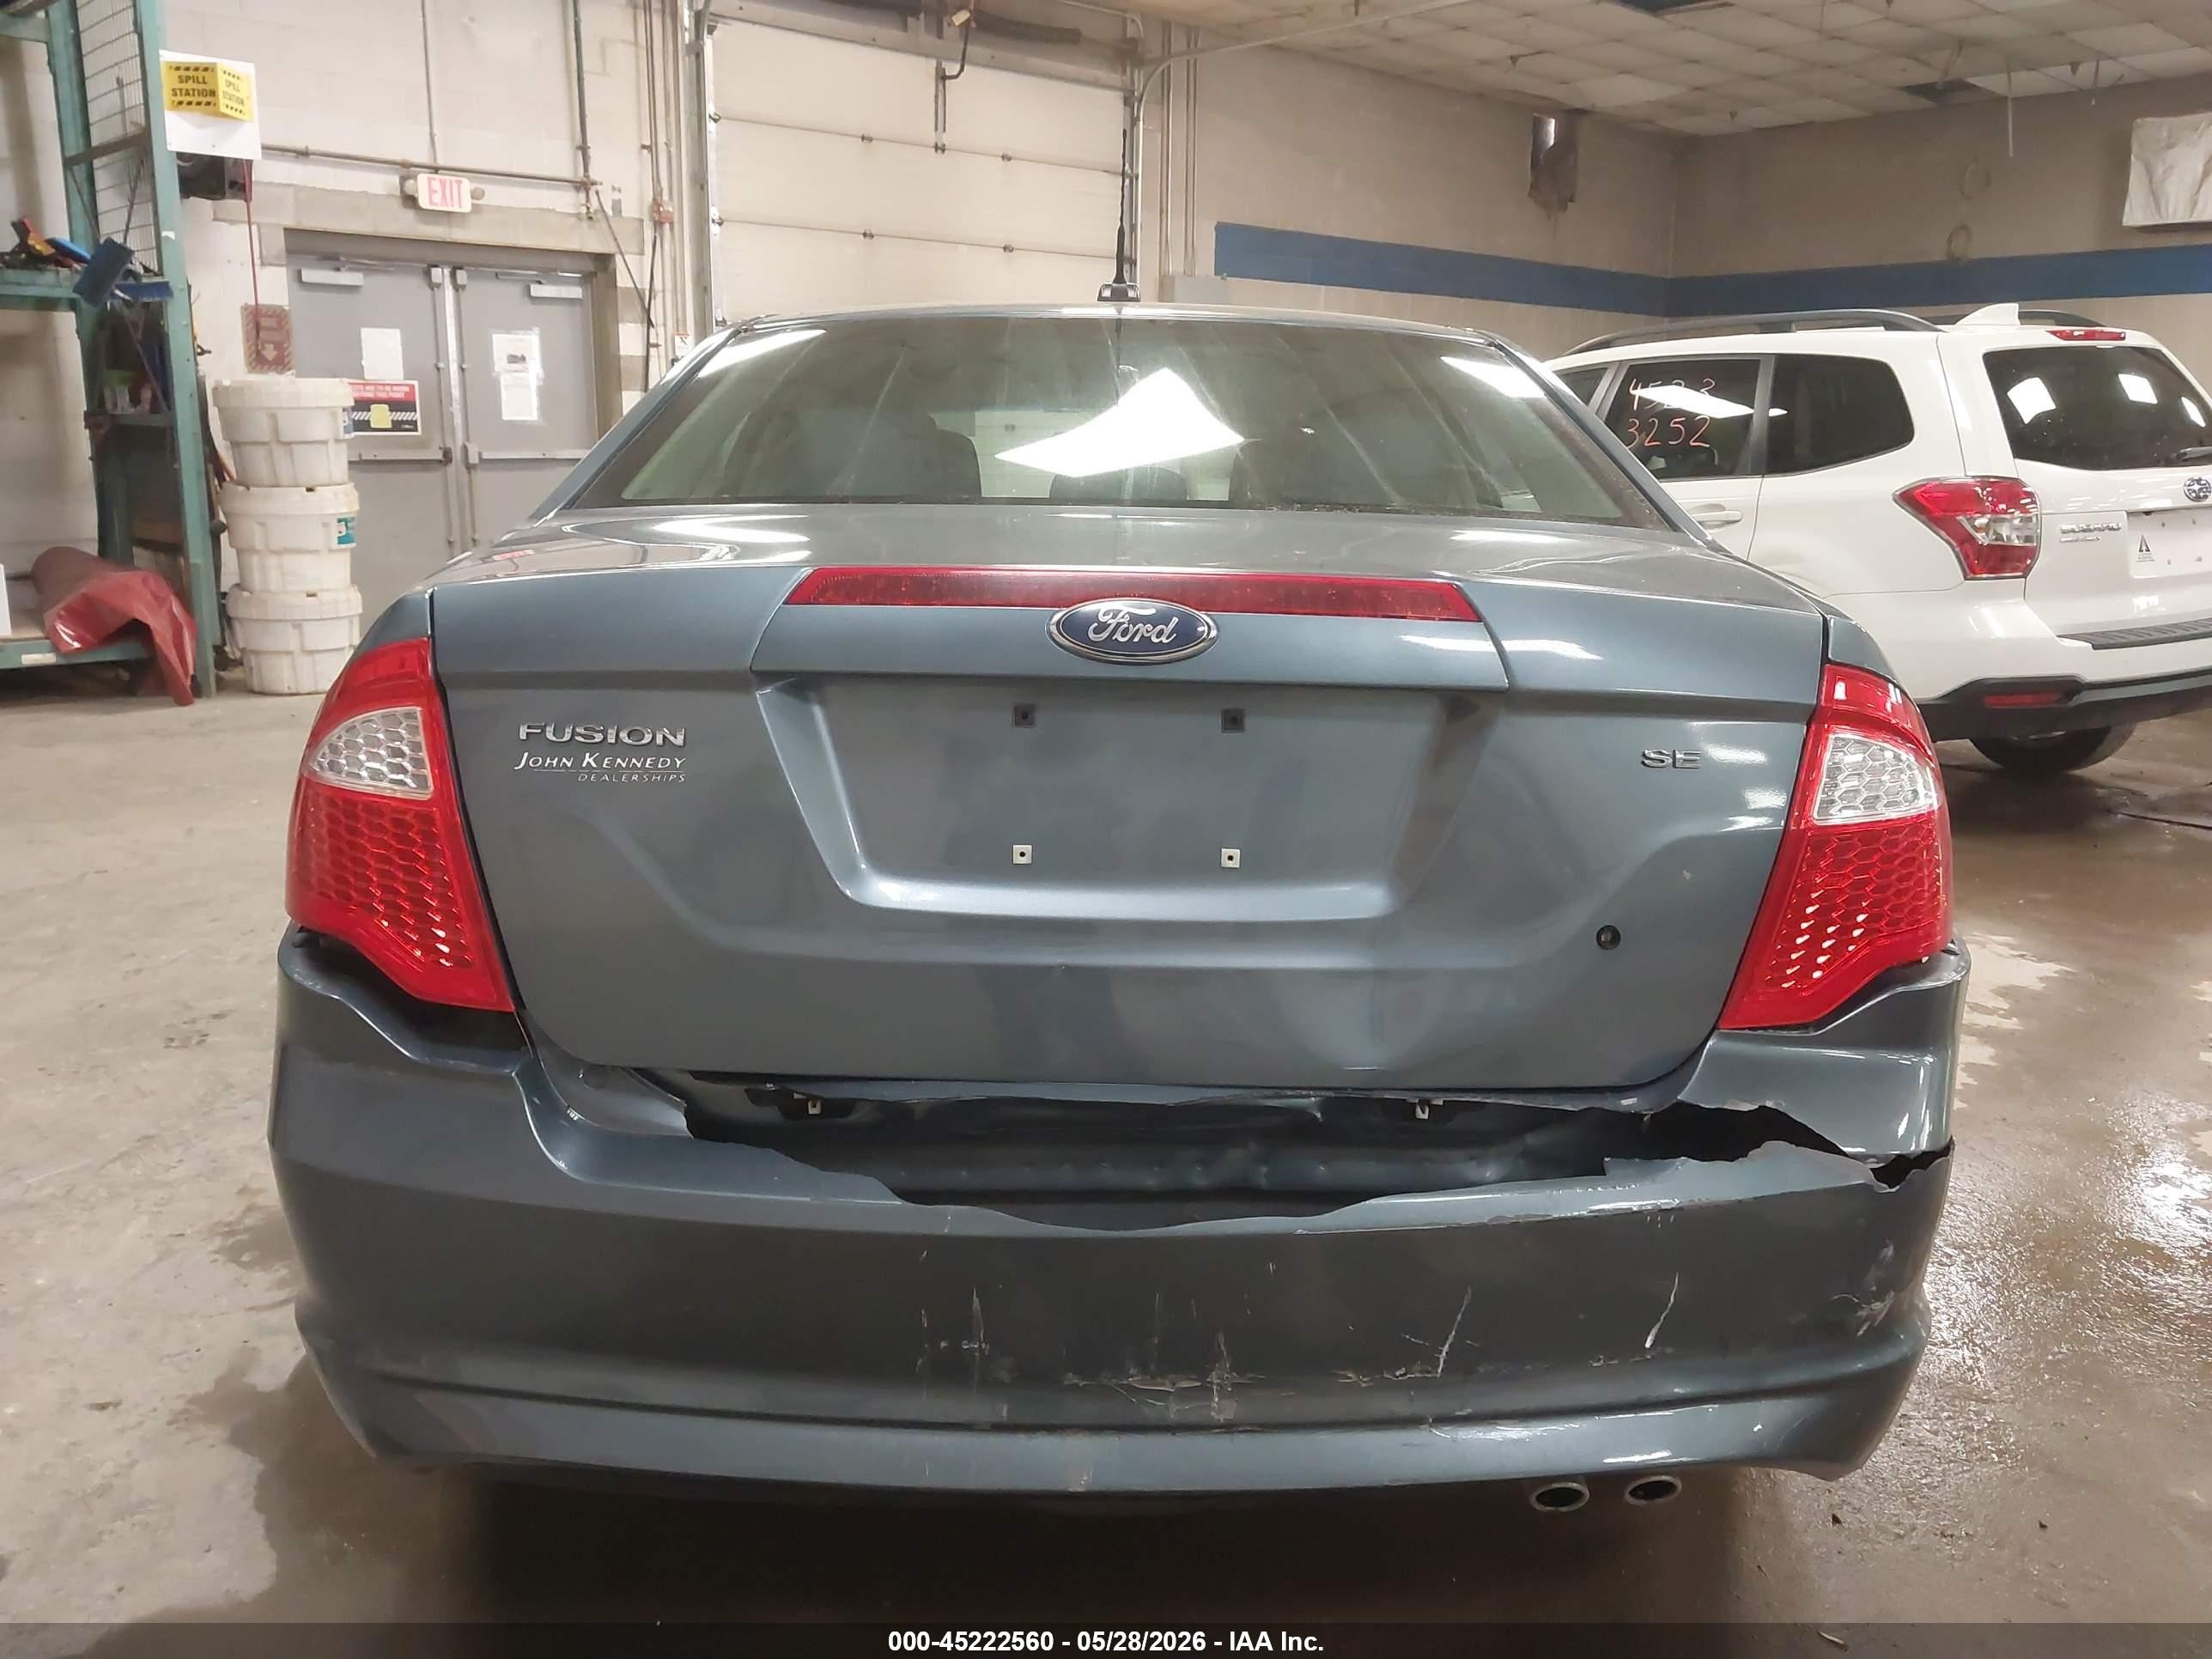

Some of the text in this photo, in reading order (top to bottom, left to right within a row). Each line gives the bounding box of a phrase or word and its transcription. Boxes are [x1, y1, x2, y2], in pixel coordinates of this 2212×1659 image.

[178, 74, 208, 85] SPILL
[225, 79, 240, 92] SPILL
[171, 88, 216, 97] STATION
[222, 90, 245, 106] STATION
[427, 176, 463, 209] EXIT
[1626, 415, 1711, 448] 3252
[1087, 605, 1179, 644] Ford
[519, 722, 685, 747] FUSION
[1641, 749, 1704, 769] SE
[577, 774, 687, 783] DEALERSHIPS
